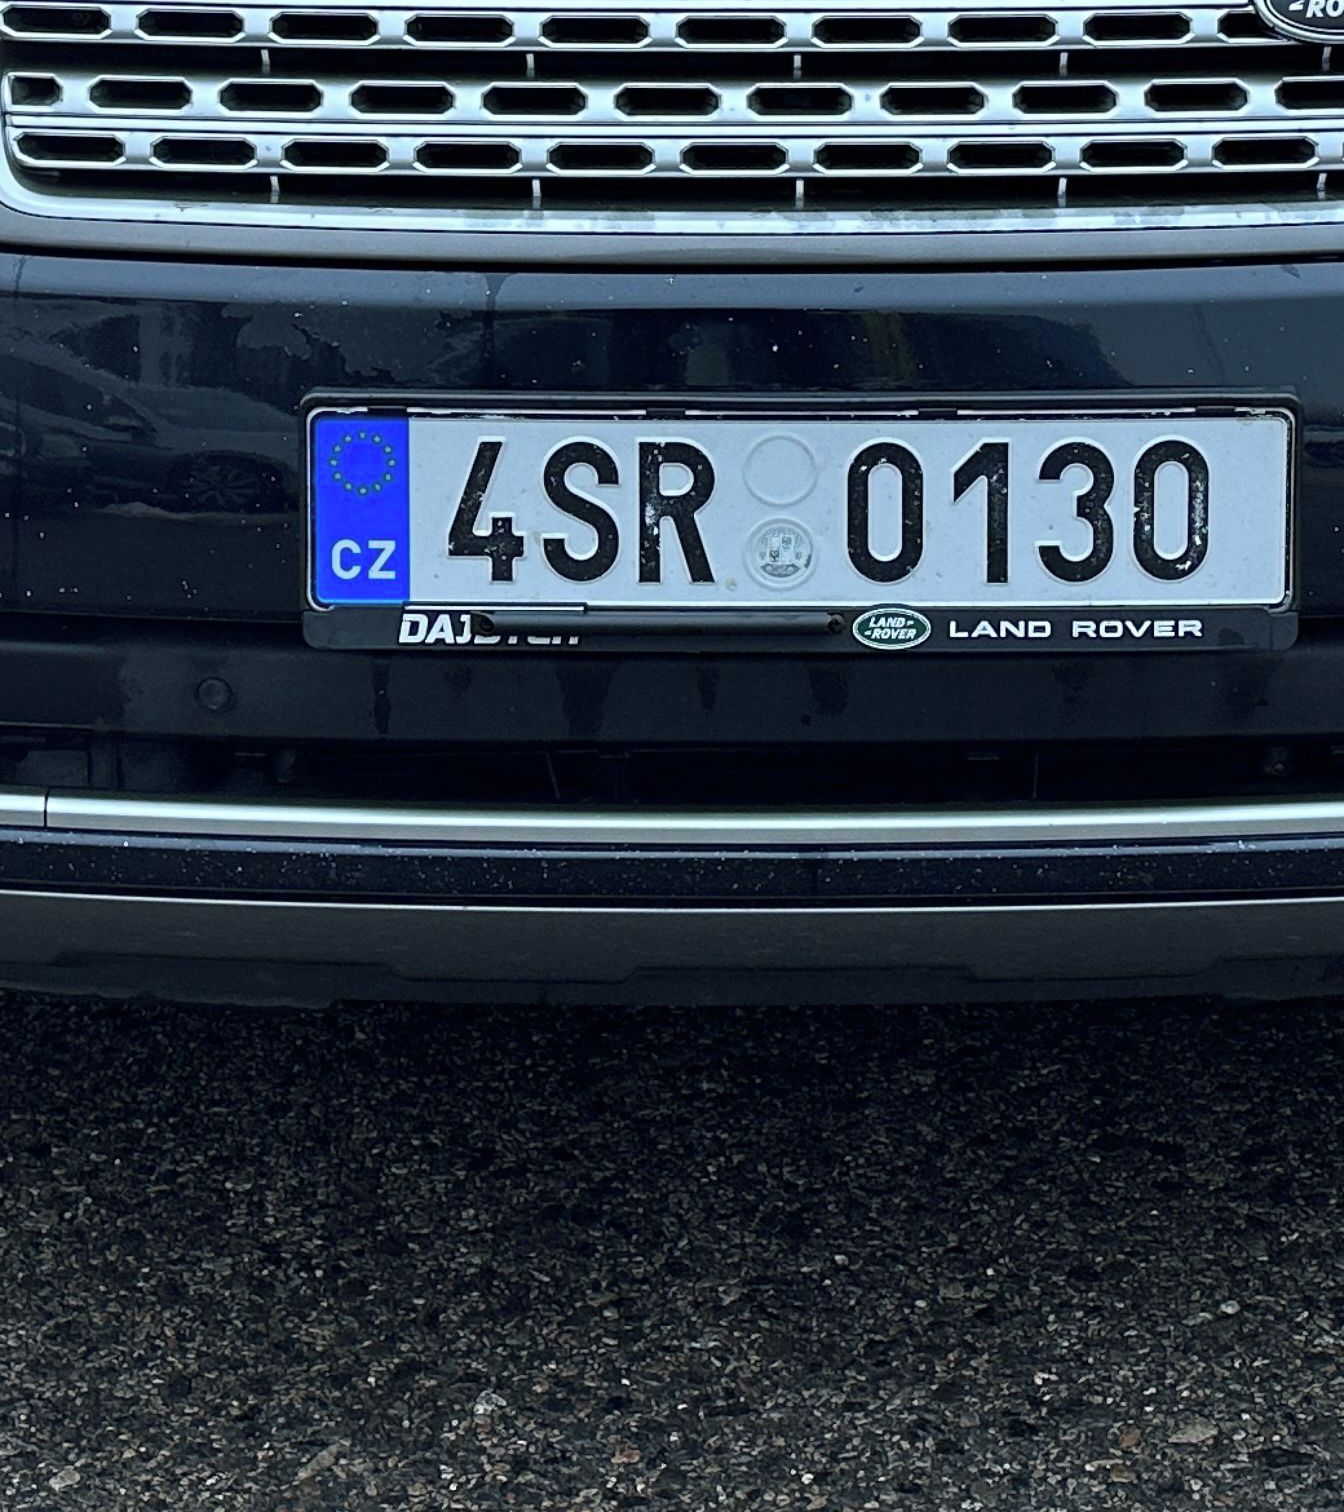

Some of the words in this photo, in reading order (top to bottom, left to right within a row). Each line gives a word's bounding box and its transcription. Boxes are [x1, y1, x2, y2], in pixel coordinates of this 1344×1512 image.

[446, 437, 718, 585] 4SR
[846, 438, 1212, 585] 0130
[330, 538, 397, 580] CZ
[949, 619, 1052, 639] LAND
[1072, 619, 1204, 638] ROVER
